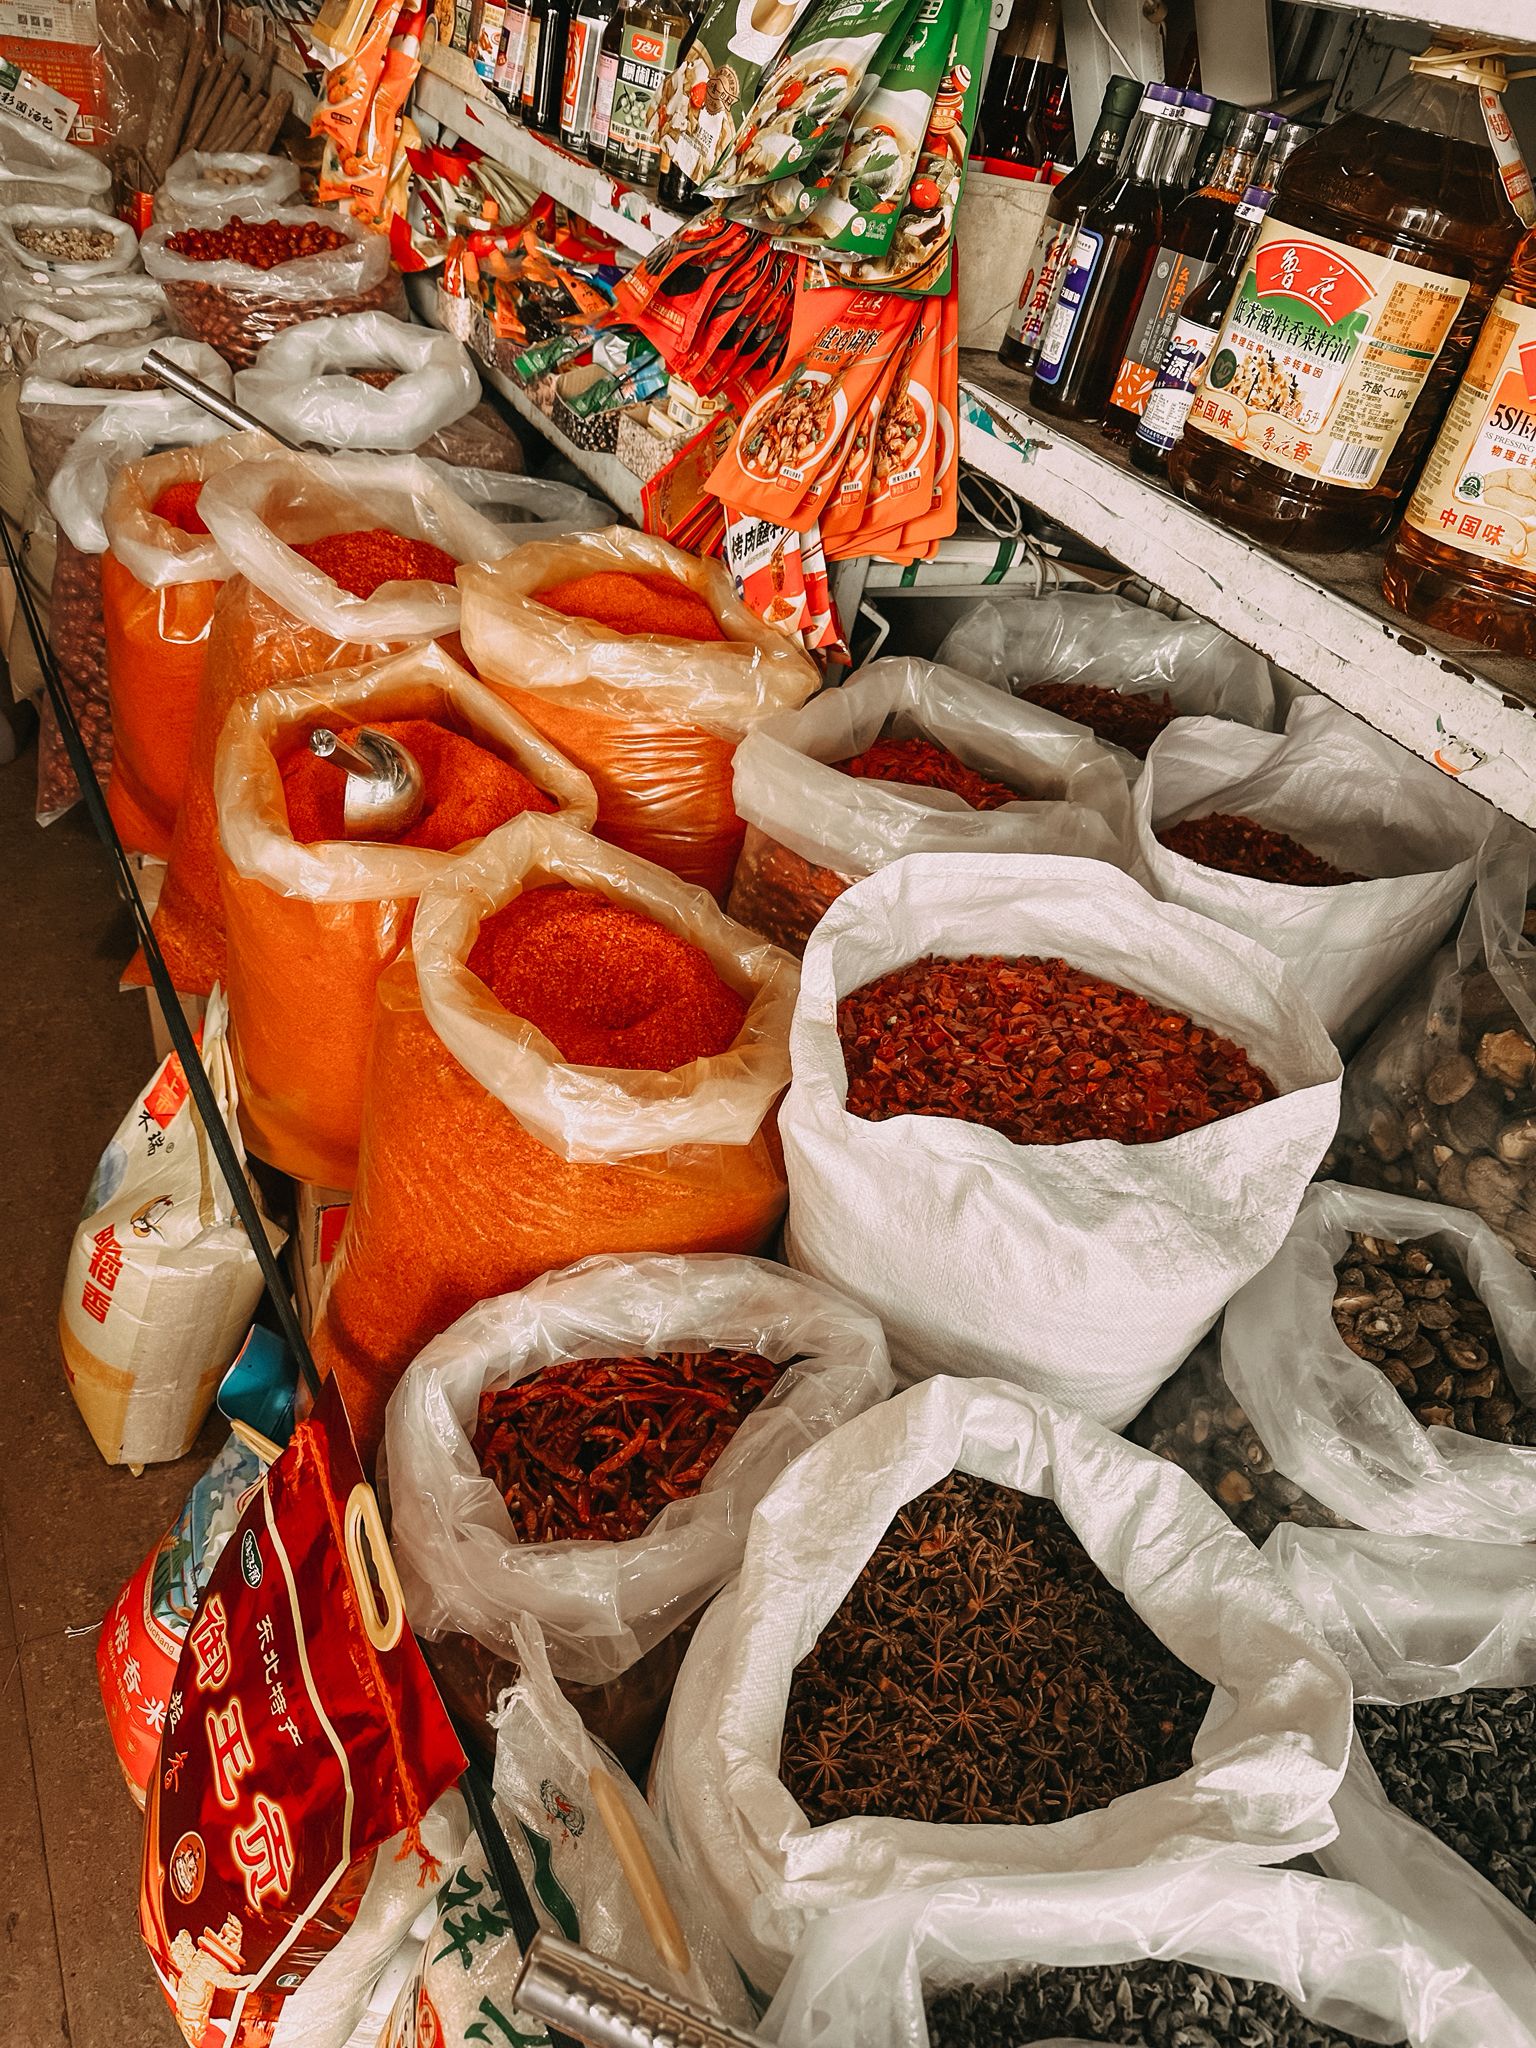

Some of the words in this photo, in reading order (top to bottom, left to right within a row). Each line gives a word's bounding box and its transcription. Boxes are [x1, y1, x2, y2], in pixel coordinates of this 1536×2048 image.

[1270, 248, 1344, 306] 鲁花
[1233, 297, 1351, 365] 低芥酸特香菜籽油
[1281, 355, 1324, 379] 非转基因
[1192, 394, 1234, 430] 中国味
[1493, 433, 1535, 454] PRESSING
[1439, 507, 1506, 546] 中国味
[255, 1614, 304, 1747] 东北特产
[188, 1595, 295, 1912] 御王贡
